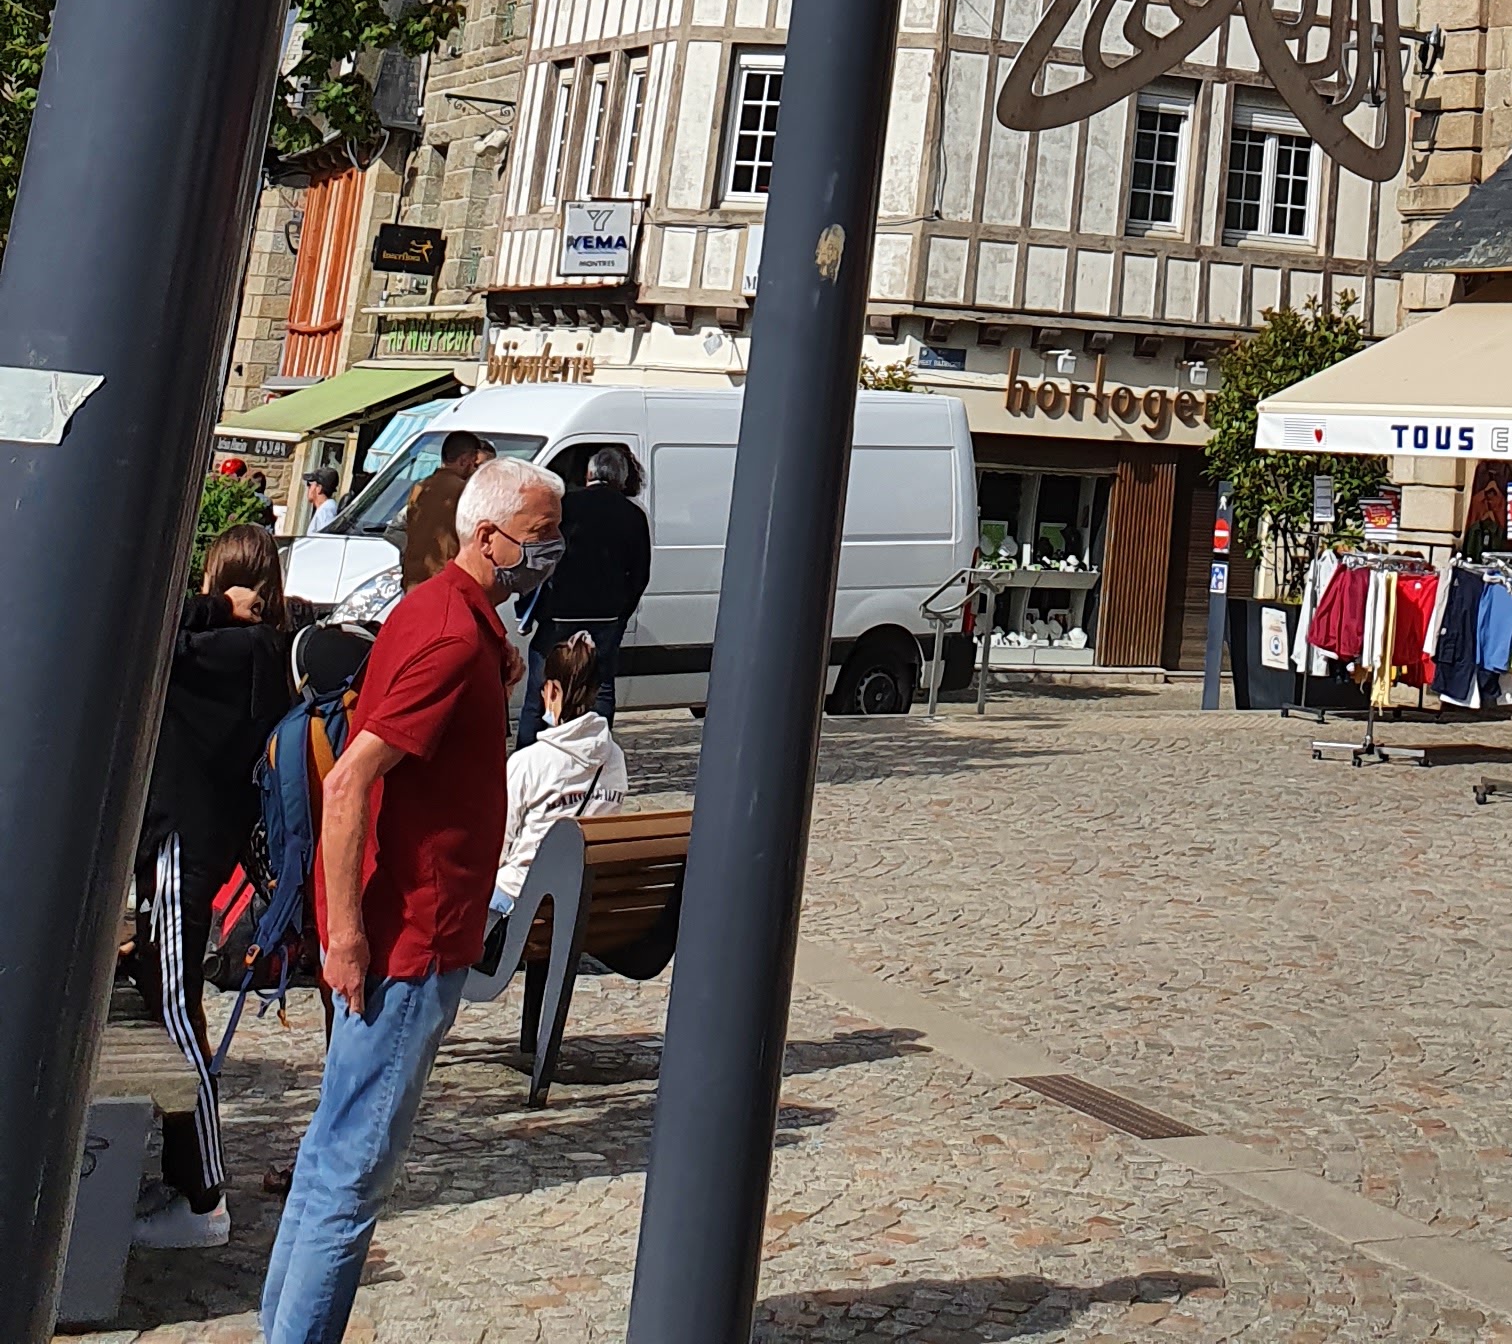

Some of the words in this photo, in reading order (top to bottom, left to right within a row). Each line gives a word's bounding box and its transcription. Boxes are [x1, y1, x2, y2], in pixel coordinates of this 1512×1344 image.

[567, 235, 628, 250] YEMA
[486, 340, 595, 385] bijouterie
[1390, 423, 1475, 452] TOUS
